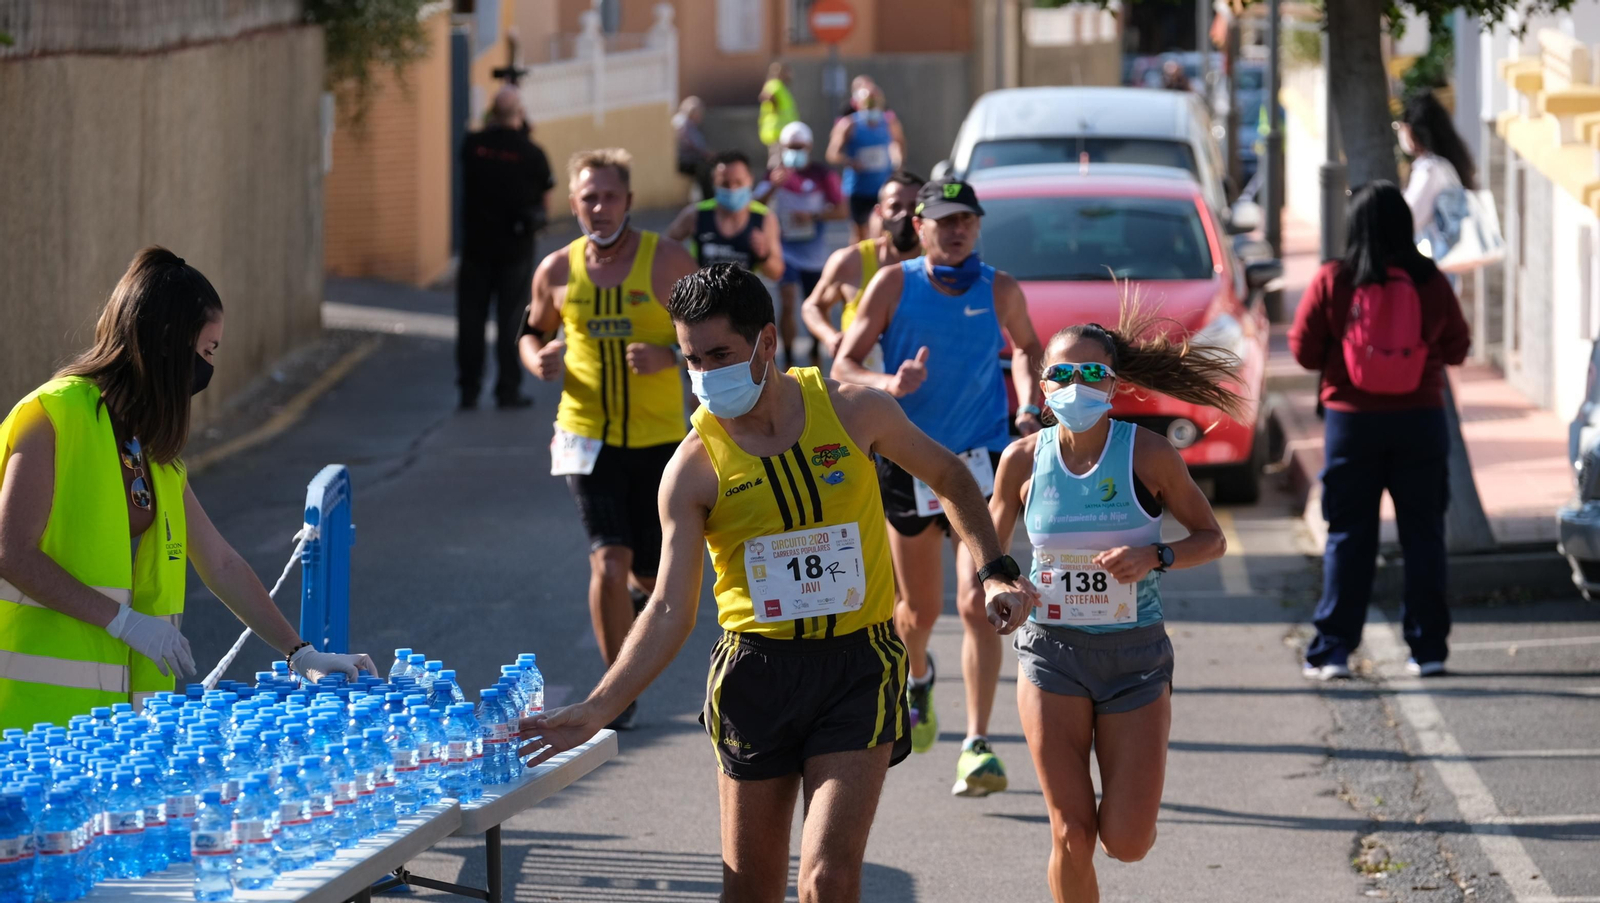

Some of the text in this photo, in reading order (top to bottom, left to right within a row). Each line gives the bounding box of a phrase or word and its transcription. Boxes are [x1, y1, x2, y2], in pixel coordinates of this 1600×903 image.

[587, 318, 632, 331] OTIS
[1048, 513, 1097, 525] Ayuntamiento
[1098, 511, 1109, 521] de
[771, 532, 830, 550] CIRCUITO 2020
[773, 543, 831, 559] CARRERAS POPULARES
[1060, 554, 1088, 564] CIRCUITO
[787, 554, 824, 581] 18
[801, 581, 821, 594] JAVI
[1060, 571, 1108, 592] 138
[1064, 594, 1109, 605] ESTEFANIA
